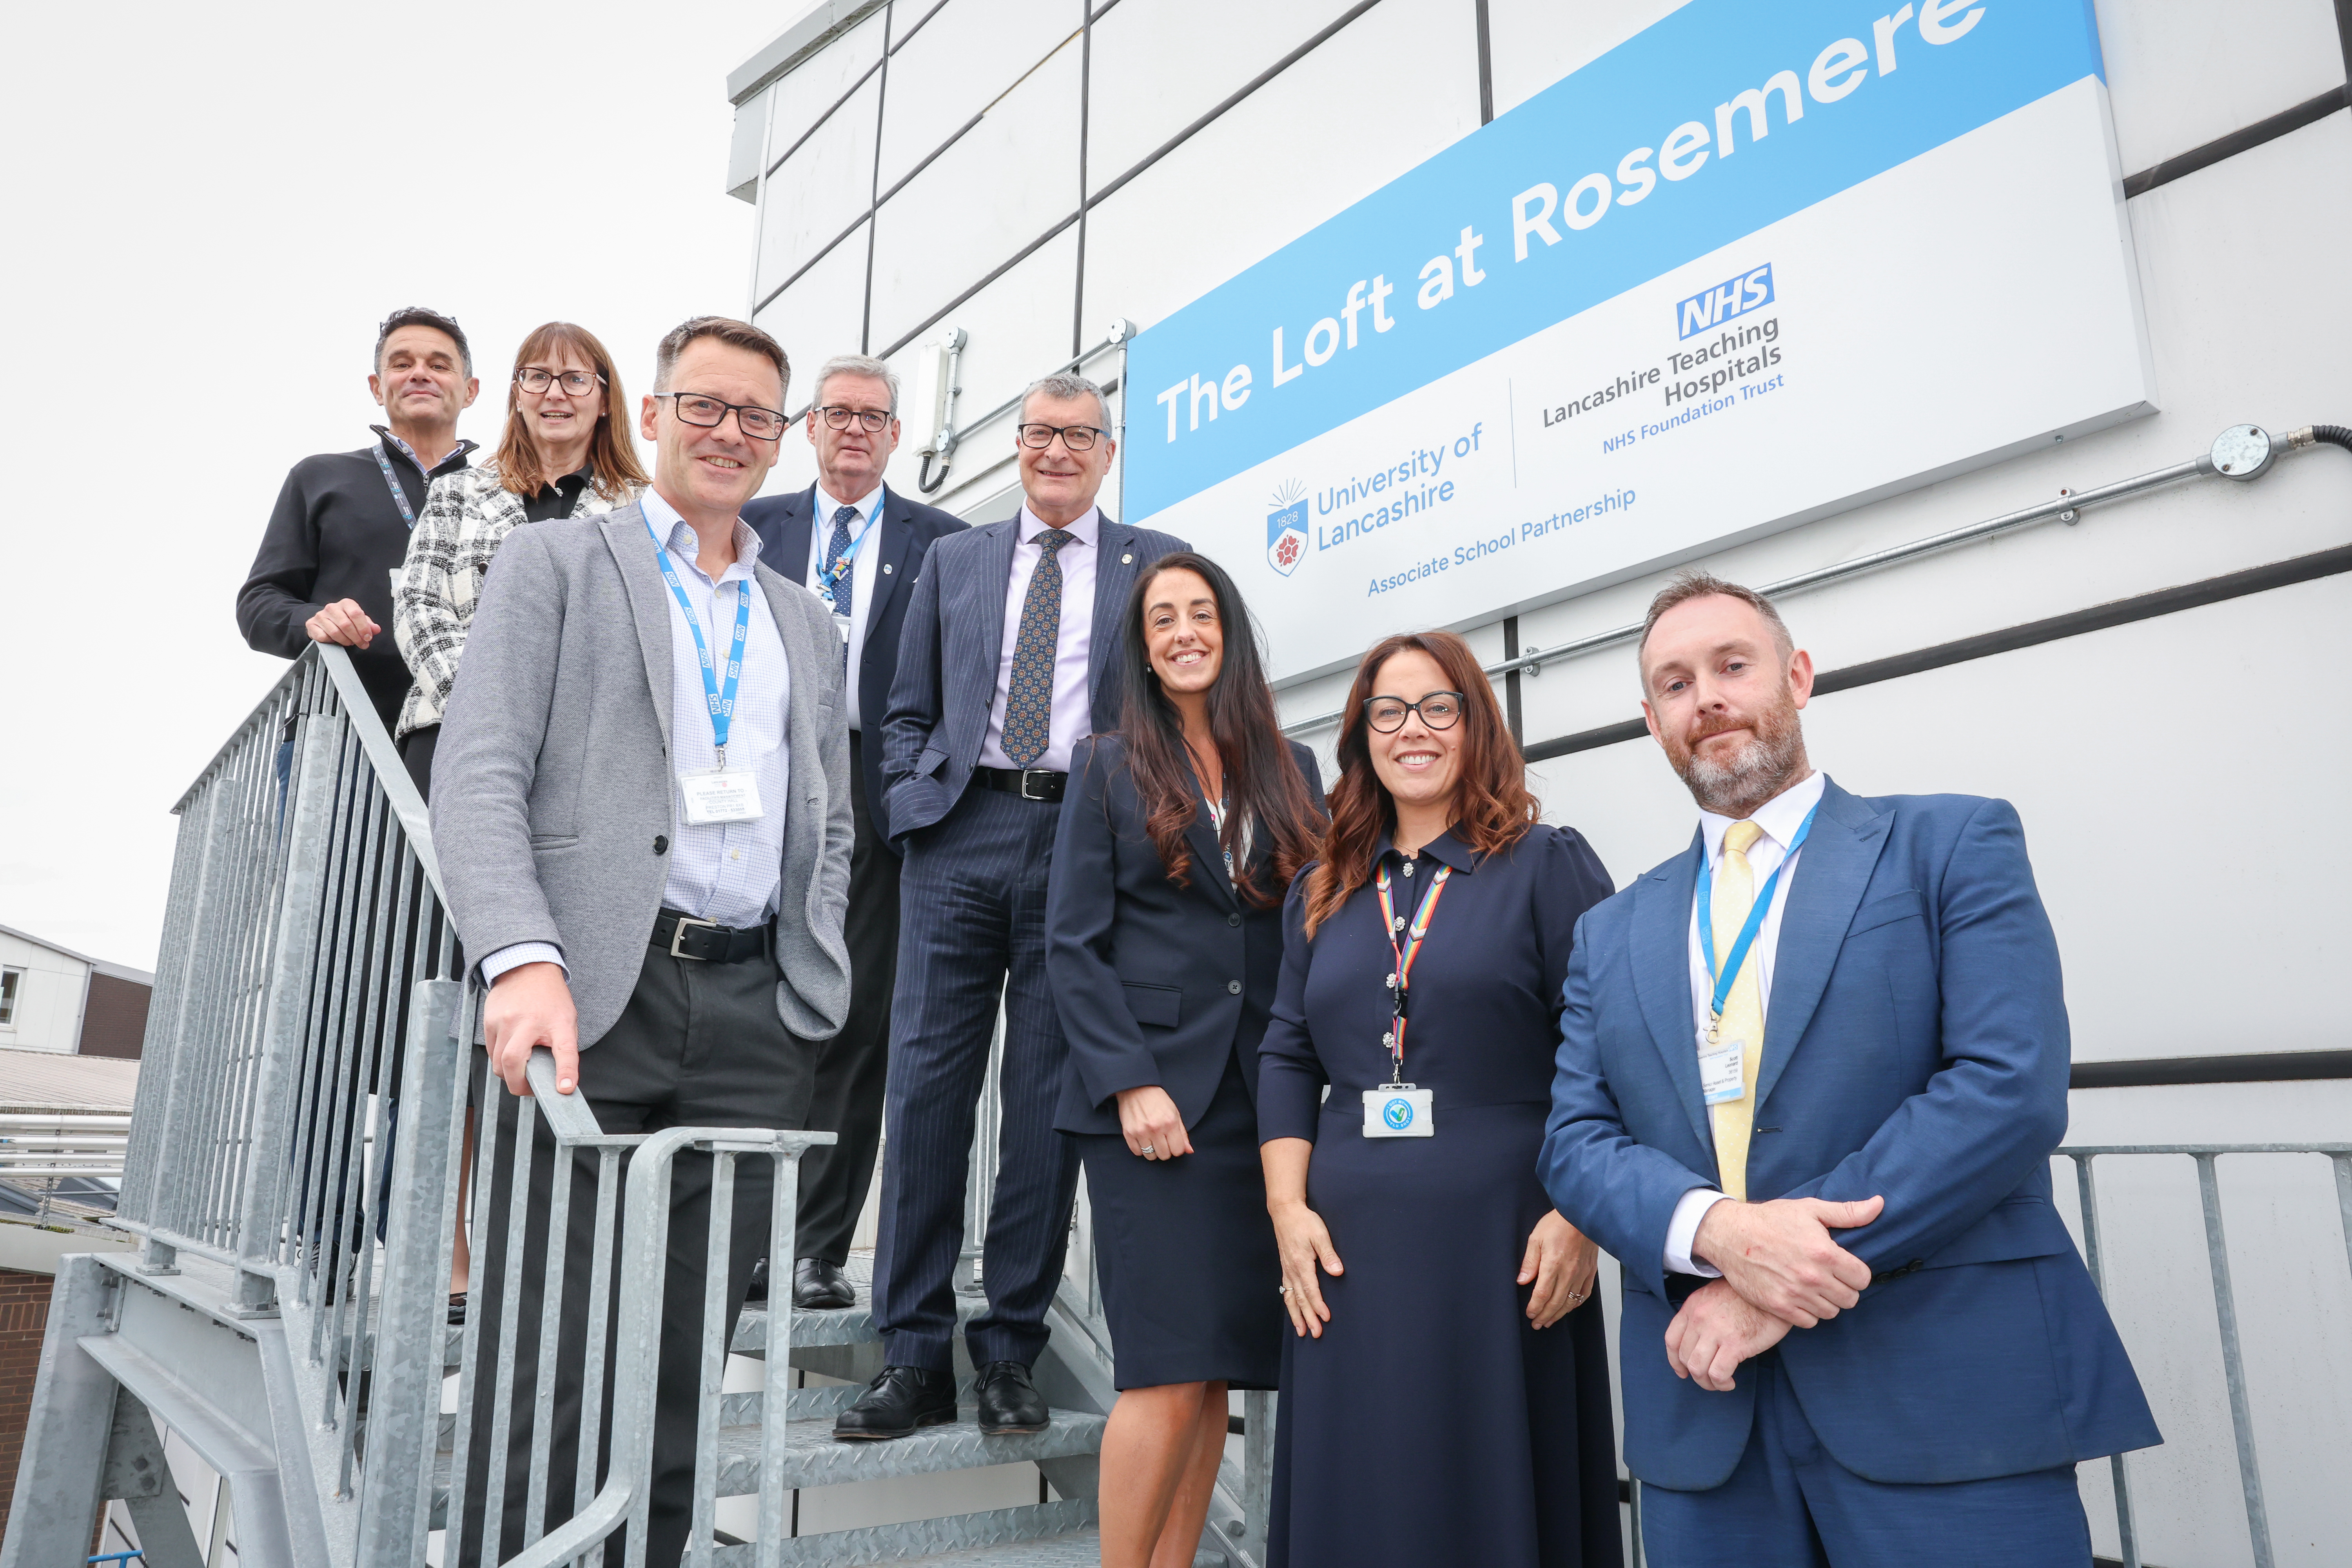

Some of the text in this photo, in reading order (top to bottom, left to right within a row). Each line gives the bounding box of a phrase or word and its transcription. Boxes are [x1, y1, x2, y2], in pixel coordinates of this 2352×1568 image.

[1157, 0, 1986, 443] The Loft at Rosemere
[1680, 267, 1769, 337] NHS
[1544, 318, 1779, 428] Lancashire Teaching
[1665, 345, 1781, 407] Hospitals
[1603, 374, 1784, 454] NHS Foundation Trust
[1318, 422, 1482, 515] University of
[1277, 511, 1298, 528] 1828
[1319, 481, 1454, 552] Lancashire
[1368, 490, 1636, 597] Associate School Partnership
[666, 572, 679, 586] NHS
[685, 608, 696, 624] NHS
[736, 624, 744, 641] NHS
[700, 648, 710, 667] NHS
[730, 661, 738, 678] NHS
[709, 695, 720, 713] NHS
[722, 700, 731, 716] NHS
[1401, 1117, 1411, 1127] SHOT
